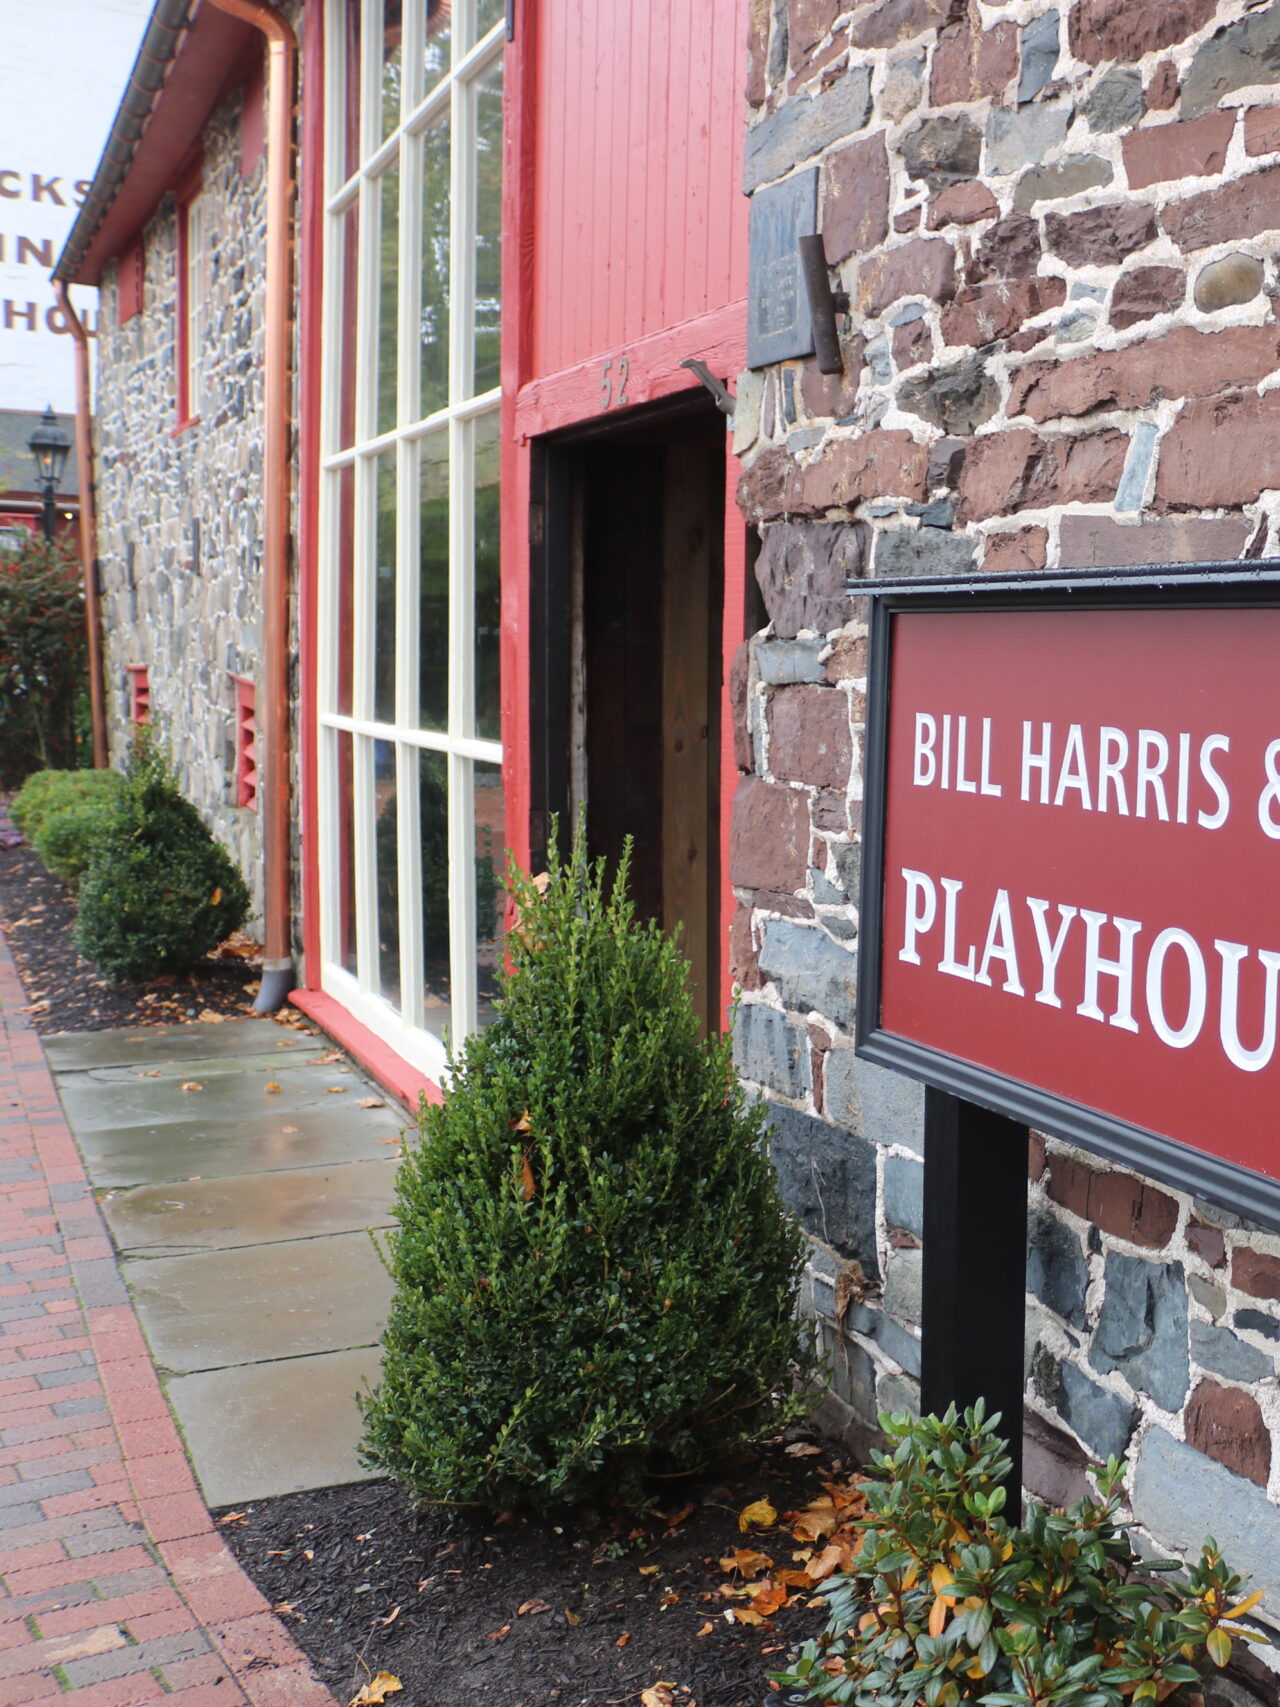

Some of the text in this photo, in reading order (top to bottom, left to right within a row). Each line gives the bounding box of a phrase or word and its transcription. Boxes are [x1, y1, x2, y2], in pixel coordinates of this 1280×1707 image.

[600, 357, 630, 409] 52
[912, 711, 1003, 798] BILL
[1020, 720, 1232, 831] HARRIS
